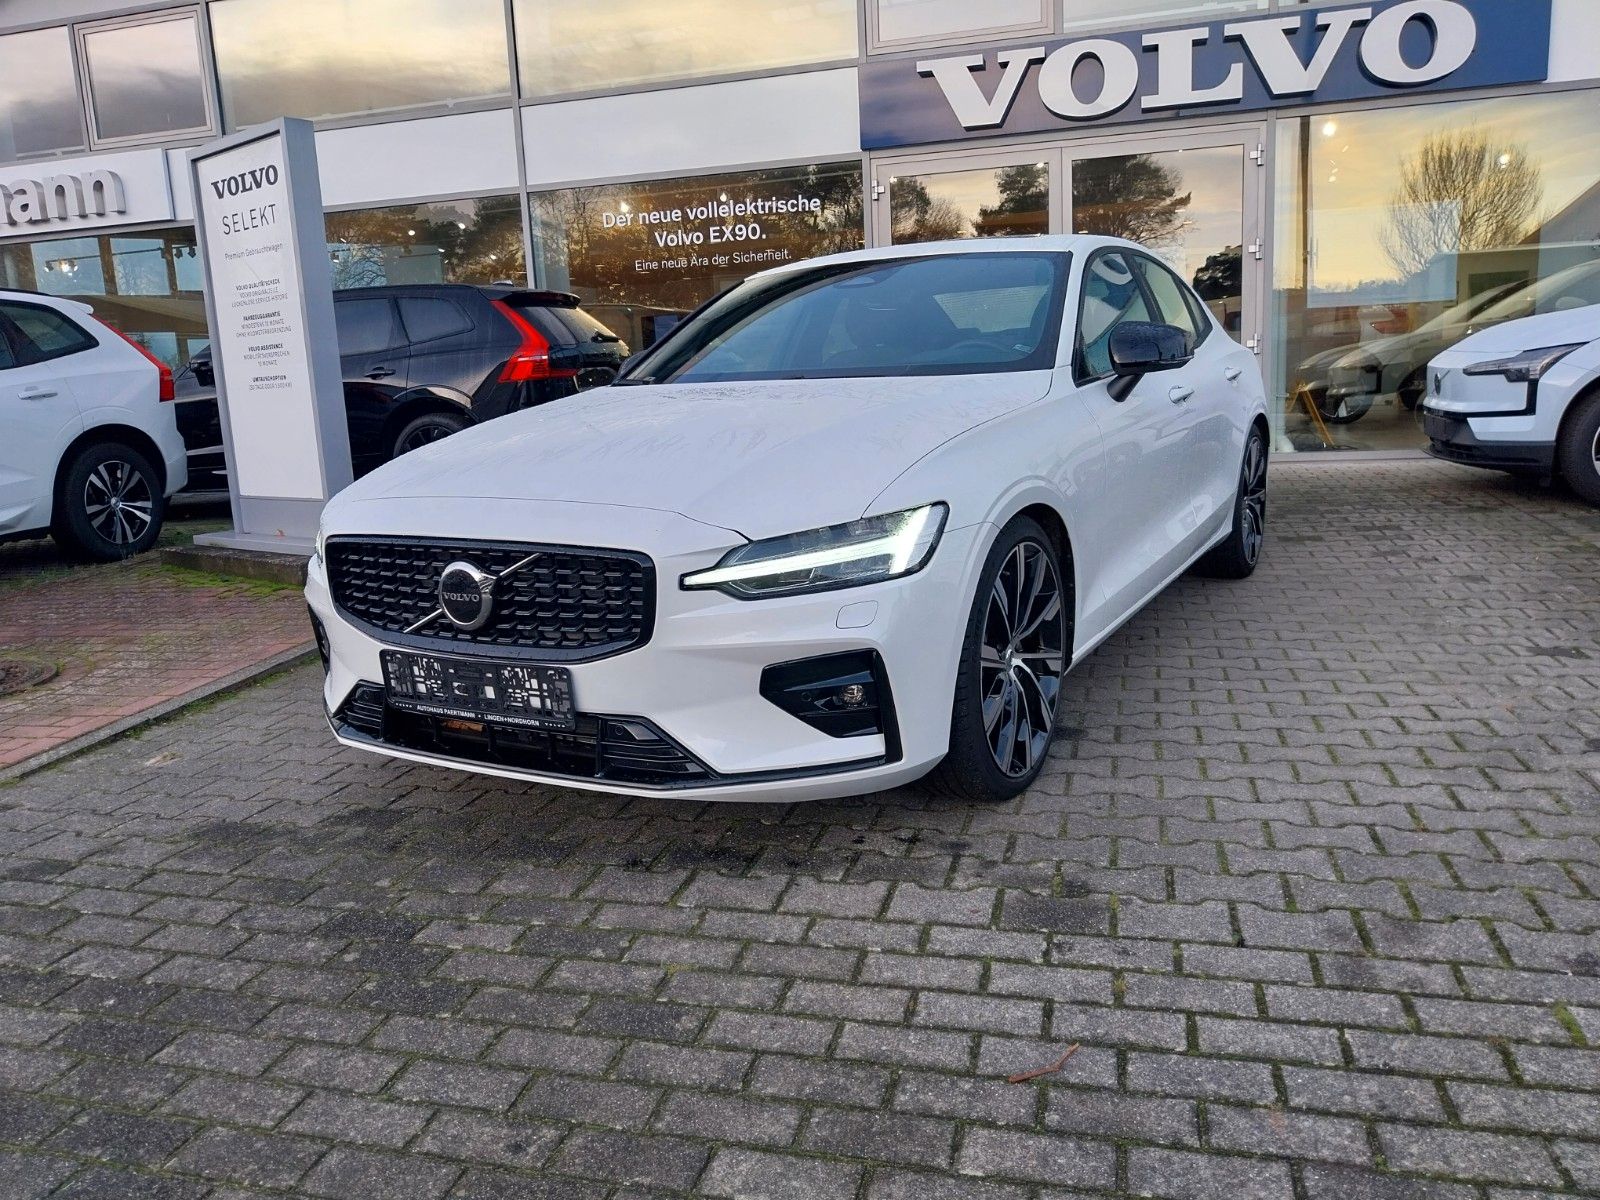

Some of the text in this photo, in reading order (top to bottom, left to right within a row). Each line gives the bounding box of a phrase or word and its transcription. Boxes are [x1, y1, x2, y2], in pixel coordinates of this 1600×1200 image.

[916, 1, 1478, 131] VOLVO
[211, 165, 279, 199] VOLVO
[222, 204, 276, 235] SELEKT
[602, 194, 822, 229] Der neue vollelektrische
[655, 224, 767, 248] Volvo EX90.
[225, 250, 245, 260] Premium
[635, 248, 793, 271] Eine neue Ära der Sicherheit.
[442, 591, 480, 602] VOLVO
[416, 704, 444, 714] AUTOHAUS
